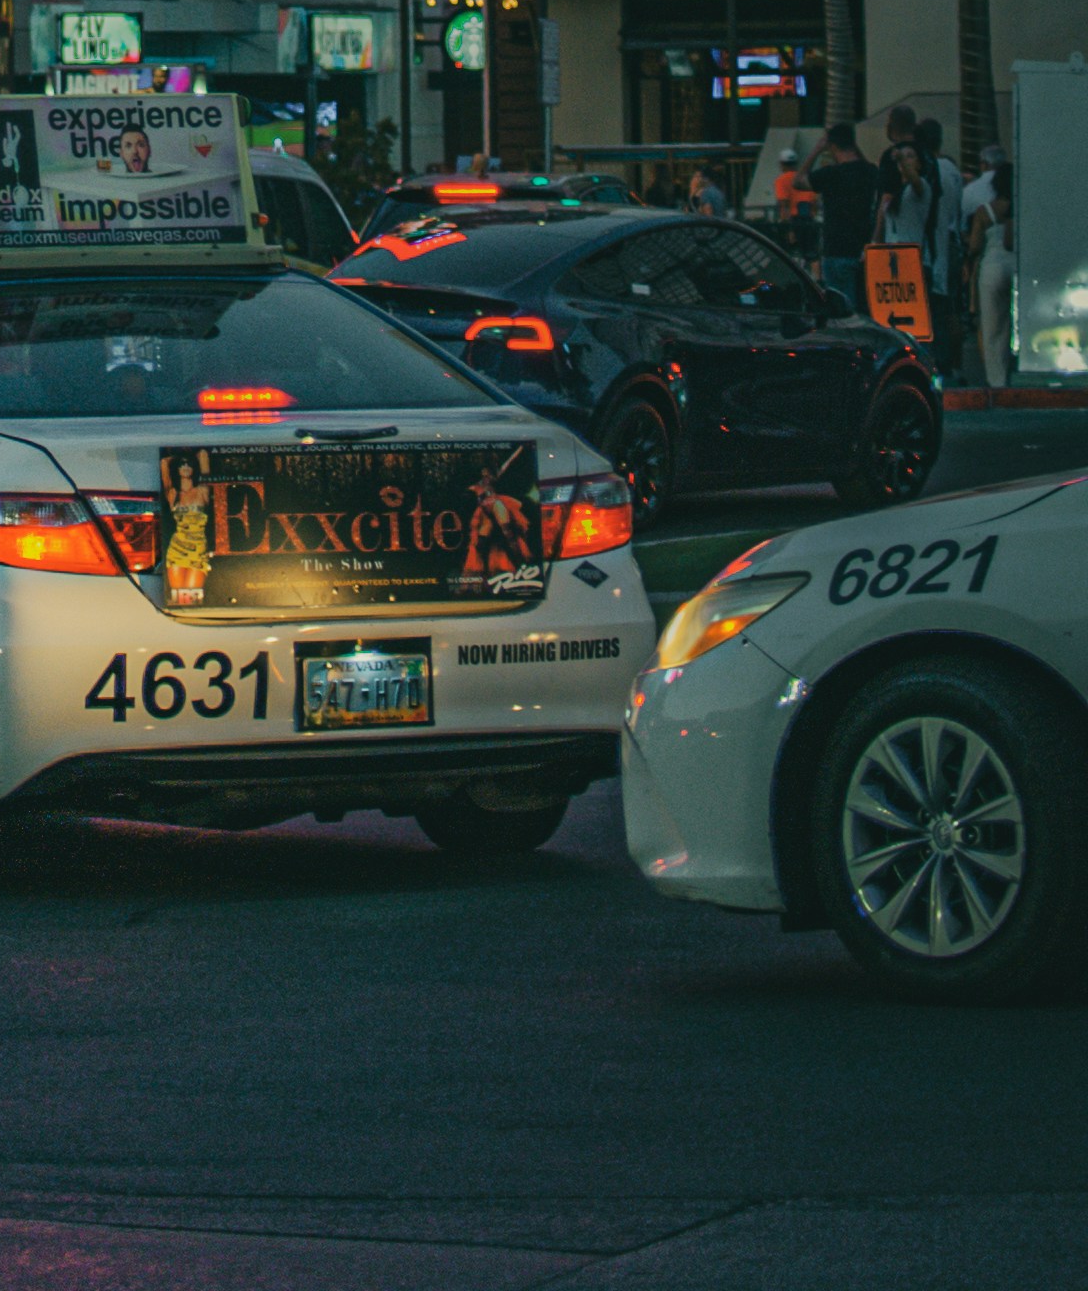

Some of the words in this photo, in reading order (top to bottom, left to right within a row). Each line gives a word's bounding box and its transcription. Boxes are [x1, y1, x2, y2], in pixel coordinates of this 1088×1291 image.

[48, 101, 222, 138] experience
[70, 130, 122, 159] the
[59, 191, 231, 231] impossible
[875, 283, 917, 304] DETOUR
[352, 443, 374, 451] WITH
[375, 443, 389, 451] AN
[208, 482, 463, 556] Exxcite
[301, 558, 333, 572] The
[341, 557, 385, 571] Show
[829, 535, 1000, 606] 6821
[488, 565, 543, 594] Rio
[333, 660, 395, 672] NEVADA
[457, 642, 498, 667] NOW
[500, 640, 557, 665] HIRING
[559, 638, 621, 662] DRIVERS
[85, 650, 269, 723] 4631
